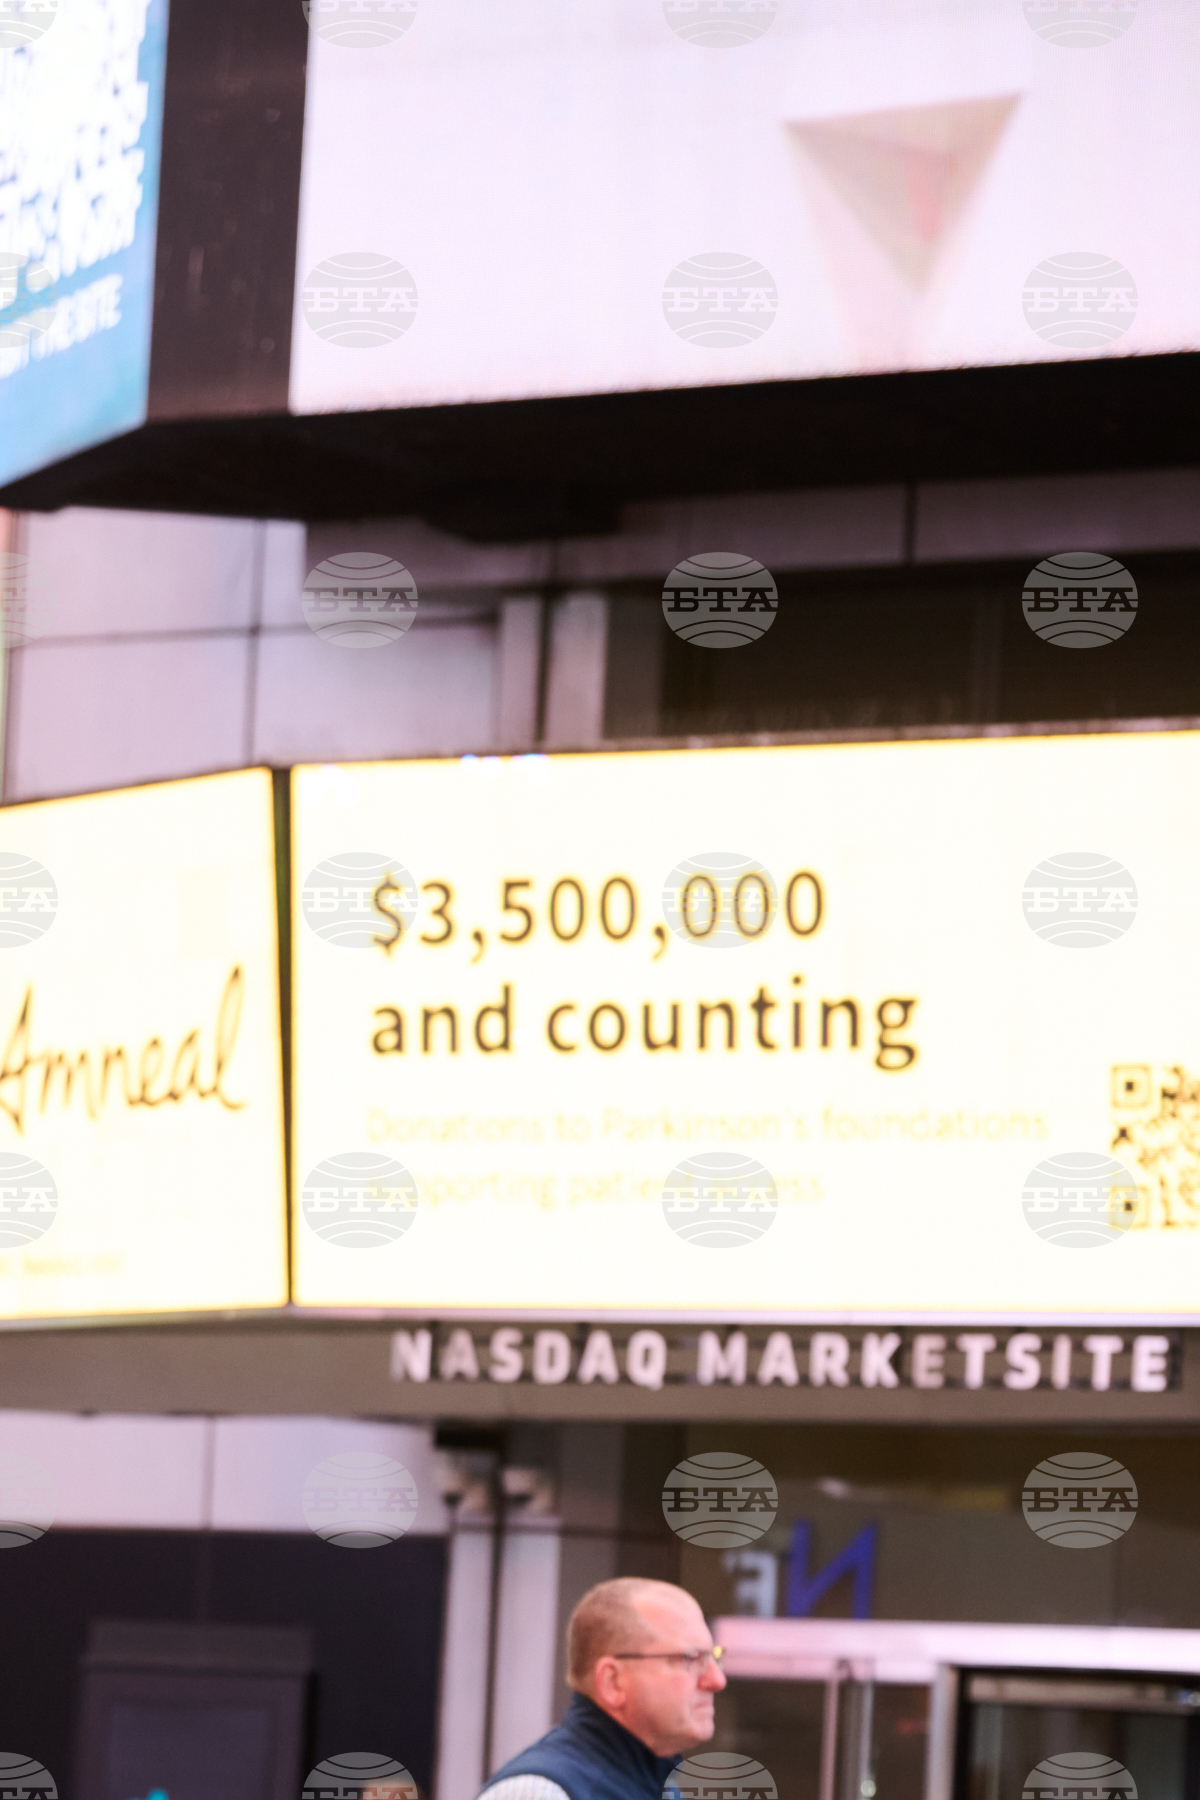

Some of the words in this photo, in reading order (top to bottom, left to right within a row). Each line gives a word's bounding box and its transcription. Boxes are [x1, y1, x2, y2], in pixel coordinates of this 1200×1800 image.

[371, 868, 827, 965] $3,500,000
[371, 984, 514, 1055] and
[545, 975, 920, 1071] counting
[392, 1328, 669, 1389] NASDAQ
[698, 1331, 1172, 1391] MARKETSITE
